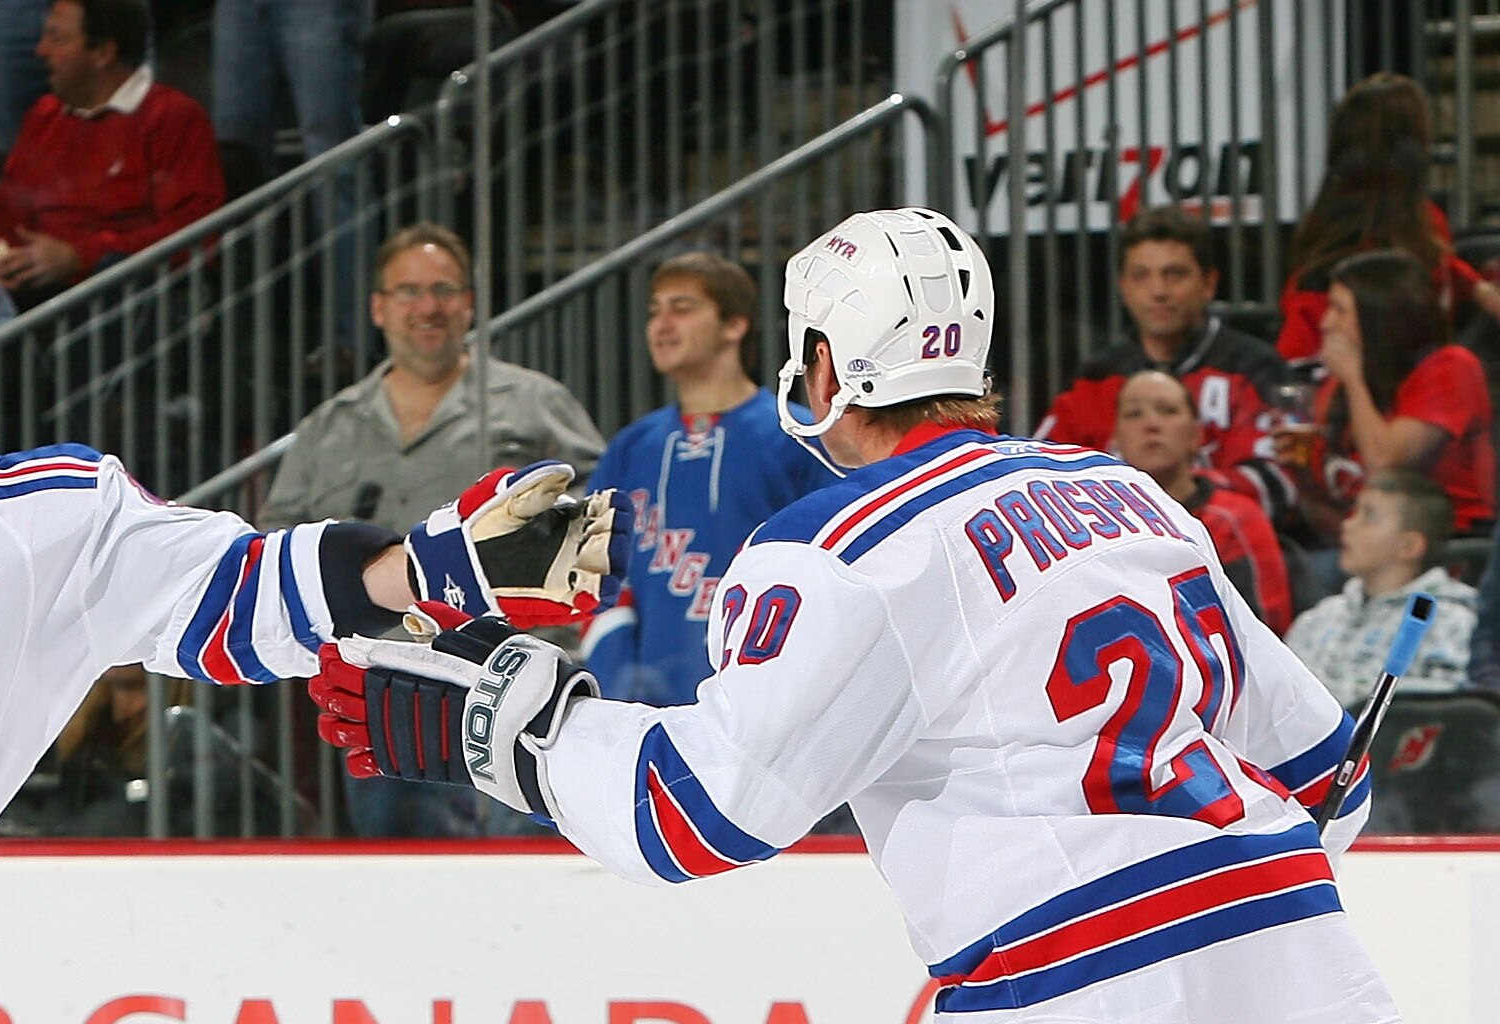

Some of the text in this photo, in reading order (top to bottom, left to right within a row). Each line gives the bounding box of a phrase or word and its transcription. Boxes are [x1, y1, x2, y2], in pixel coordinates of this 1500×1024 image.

[964, 140, 1263, 222] verizon
[825, 235, 858, 262] NYR
[921, 323, 961, 359] 20
